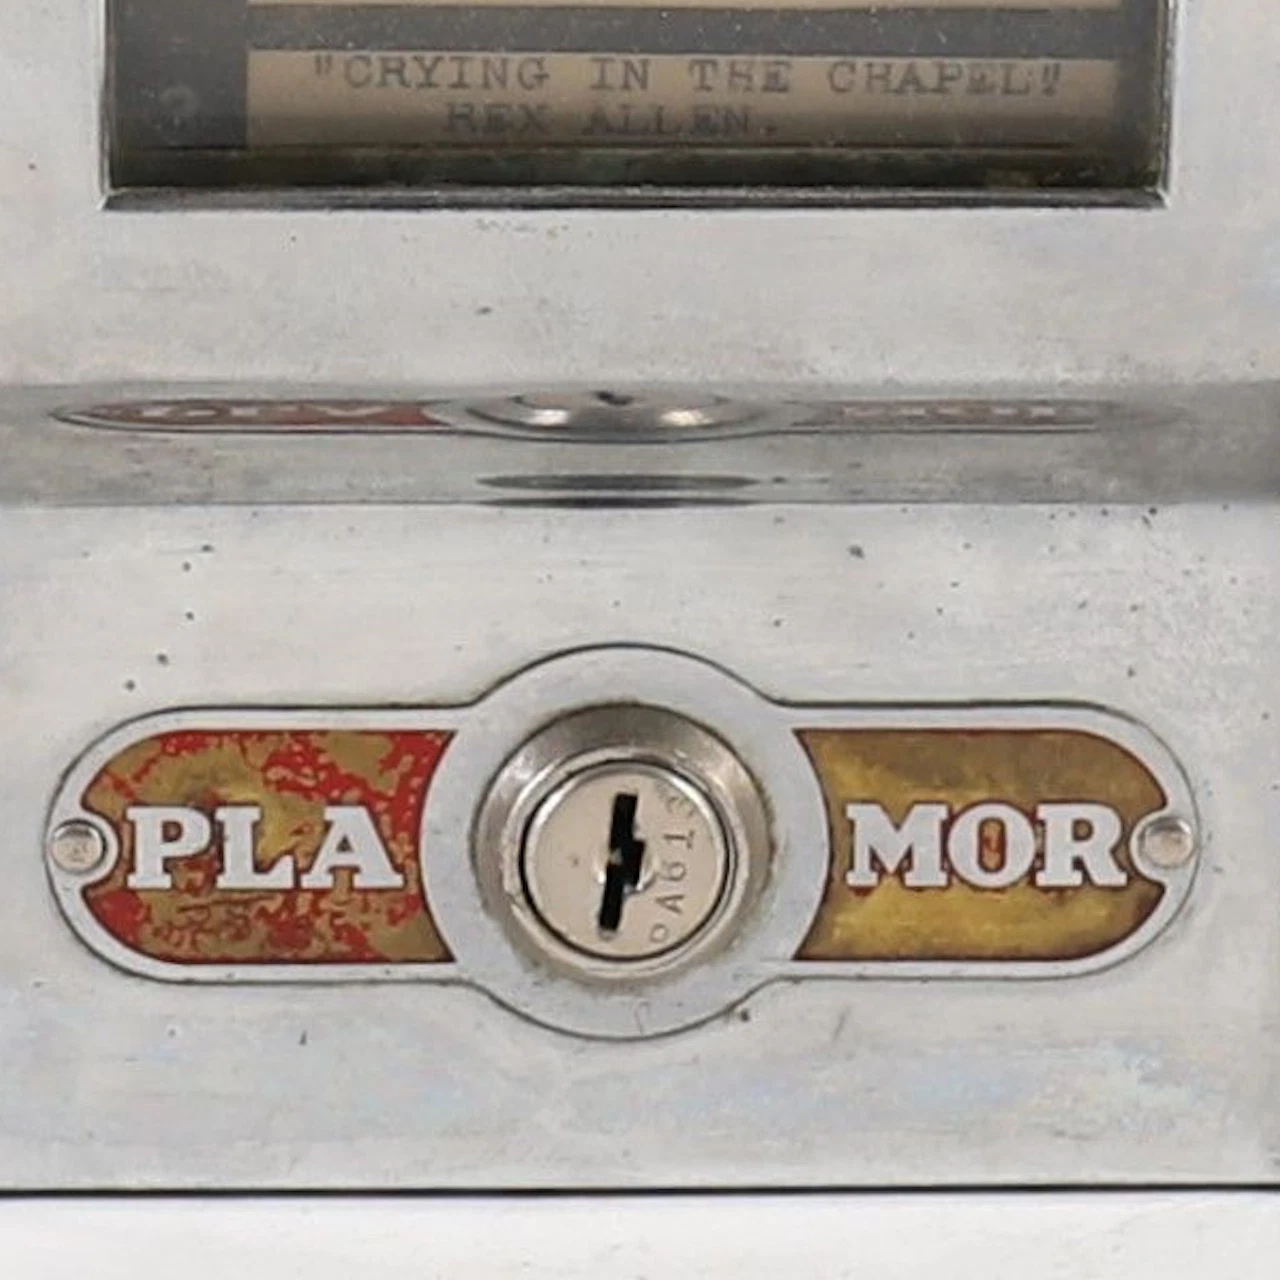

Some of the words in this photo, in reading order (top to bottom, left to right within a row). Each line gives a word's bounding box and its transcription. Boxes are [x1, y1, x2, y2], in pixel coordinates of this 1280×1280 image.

[588, 57, 652, 92] IN
[688, 59, 792, 94] THE
[125, 804, 404, 890] PLA
[846, 801, 1128, 889] MOR
